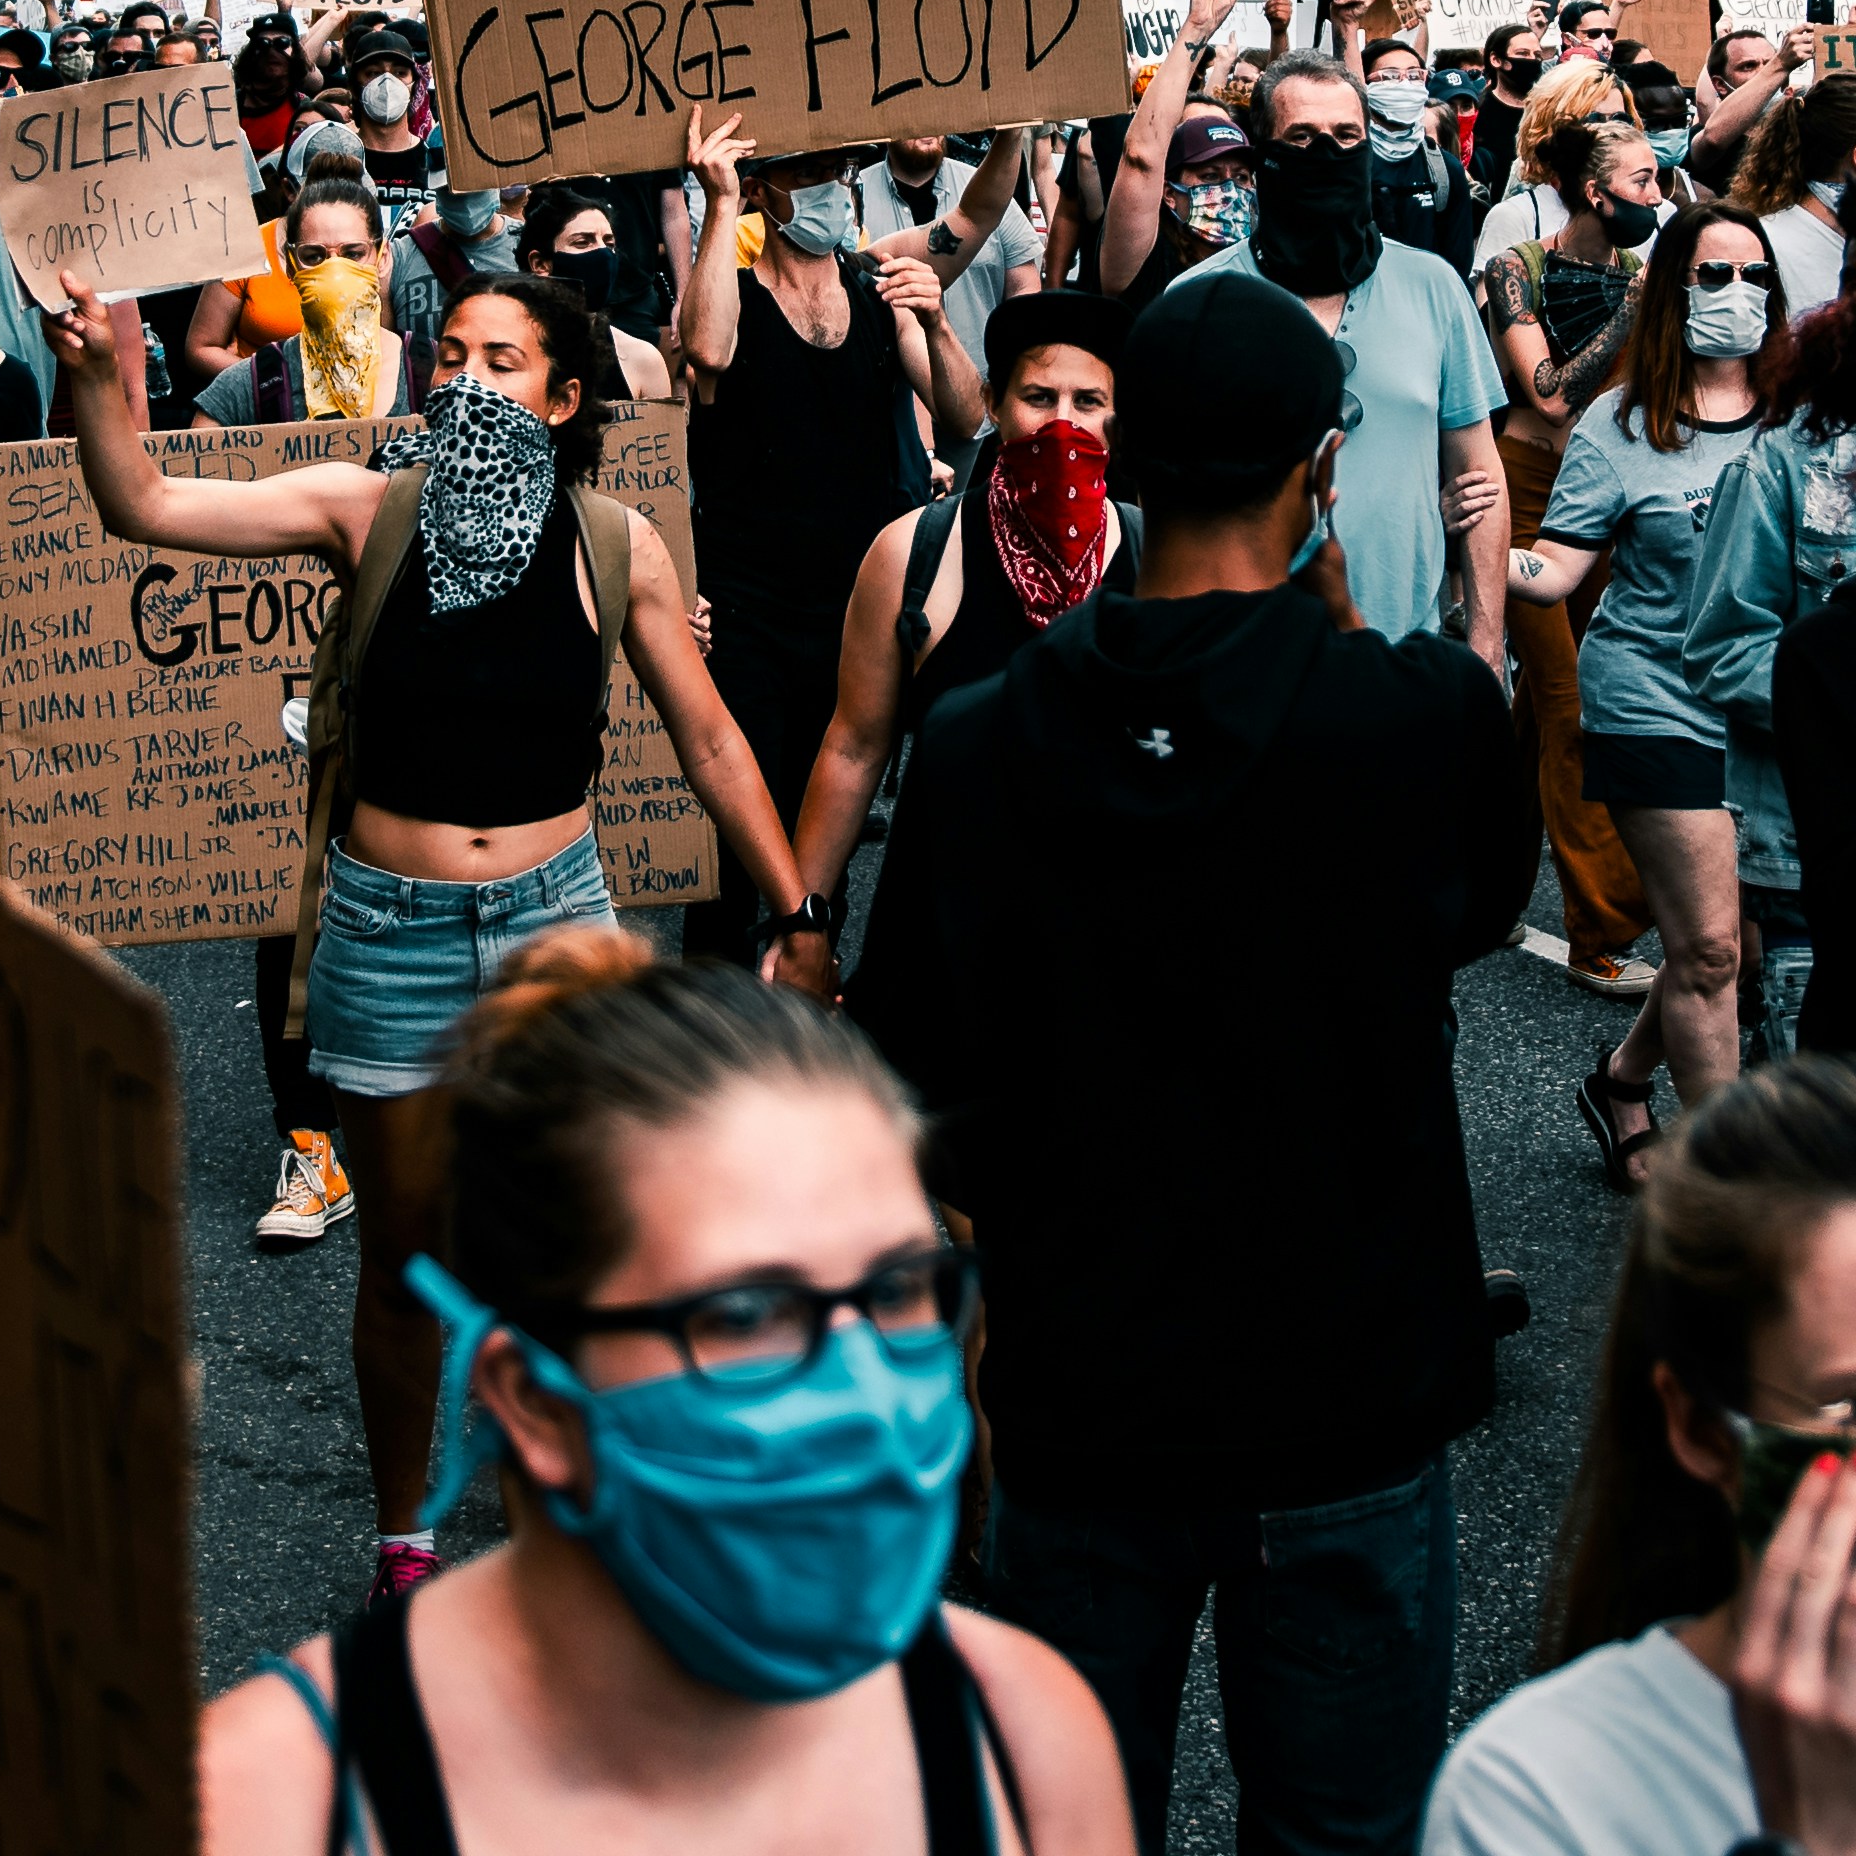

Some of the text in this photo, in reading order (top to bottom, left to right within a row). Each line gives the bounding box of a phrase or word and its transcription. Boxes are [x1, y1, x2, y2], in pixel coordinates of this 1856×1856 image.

[11, 83, 239, 182] SILENCE
[83, 179, 105, 214] is
[26, 183, 230, 277] complicity
[281, 426, 362, 466] MILES
[188, 555, 289, 585] TRAYVON
[0, 639, 133, 689] MOHAMED
[133, 656, 244, 690] DEANDRE
[127, 685, 222, 719] BERHE
[5, 720, 254, 783] DARIUS TARVER
[131, 756, 231, 786] ANTHONY
[5, 787, 112, 828] KWAME
[175, 777, 257, 808] JONES
[215, 799, 293, 828] MANUEL
[7, 833, 129, 880] GREGORY
[136, 831, 197, 867] HILL
[199, 834, 236, 856] JR
[206, 864, 295, 896] WILLIE
[626, 856, 700, 894] BROWN
[149, 901, 212, 930] SHEM
[216, 894, 278, 927] JEAN
